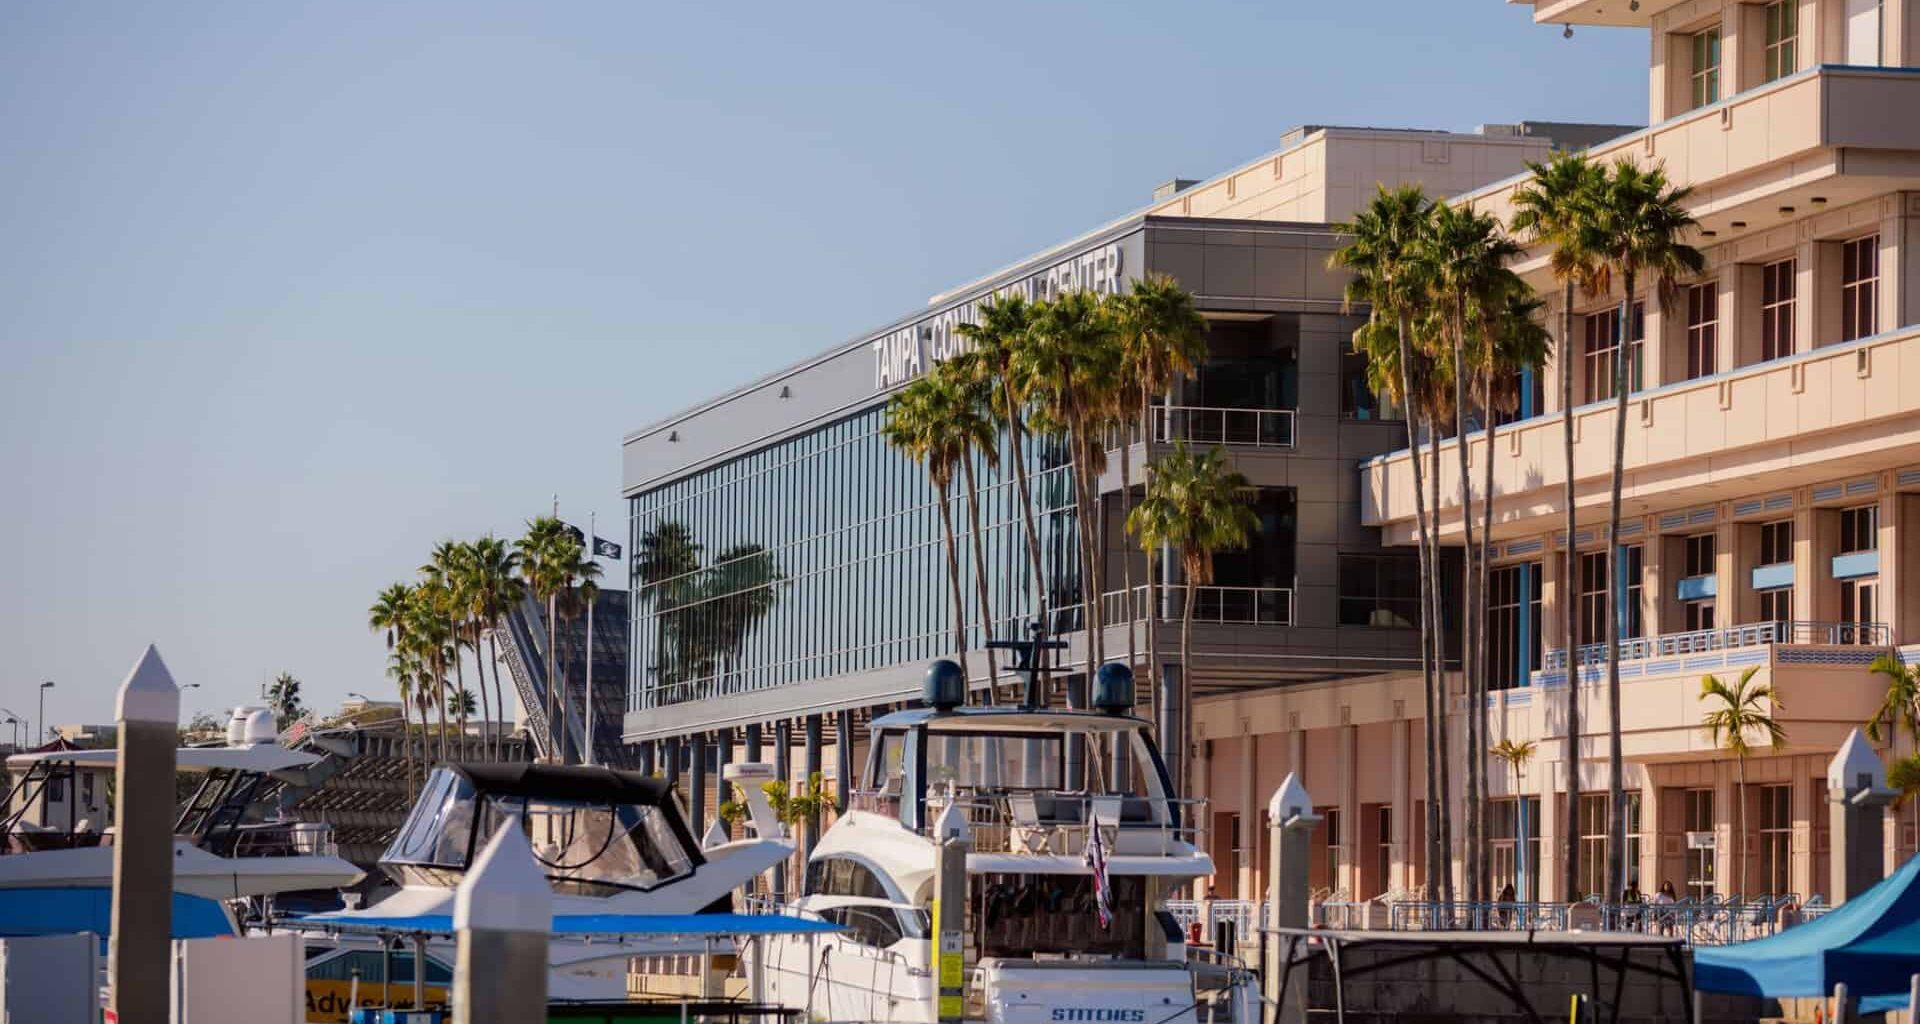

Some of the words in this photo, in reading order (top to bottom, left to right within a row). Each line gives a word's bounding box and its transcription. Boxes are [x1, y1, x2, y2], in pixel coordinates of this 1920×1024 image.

[873, 325, 922, 389] TAMPA
[1047, 243, 1121, 302] CENTER
[1052, 1008, 1144, 1021] STITCHES
